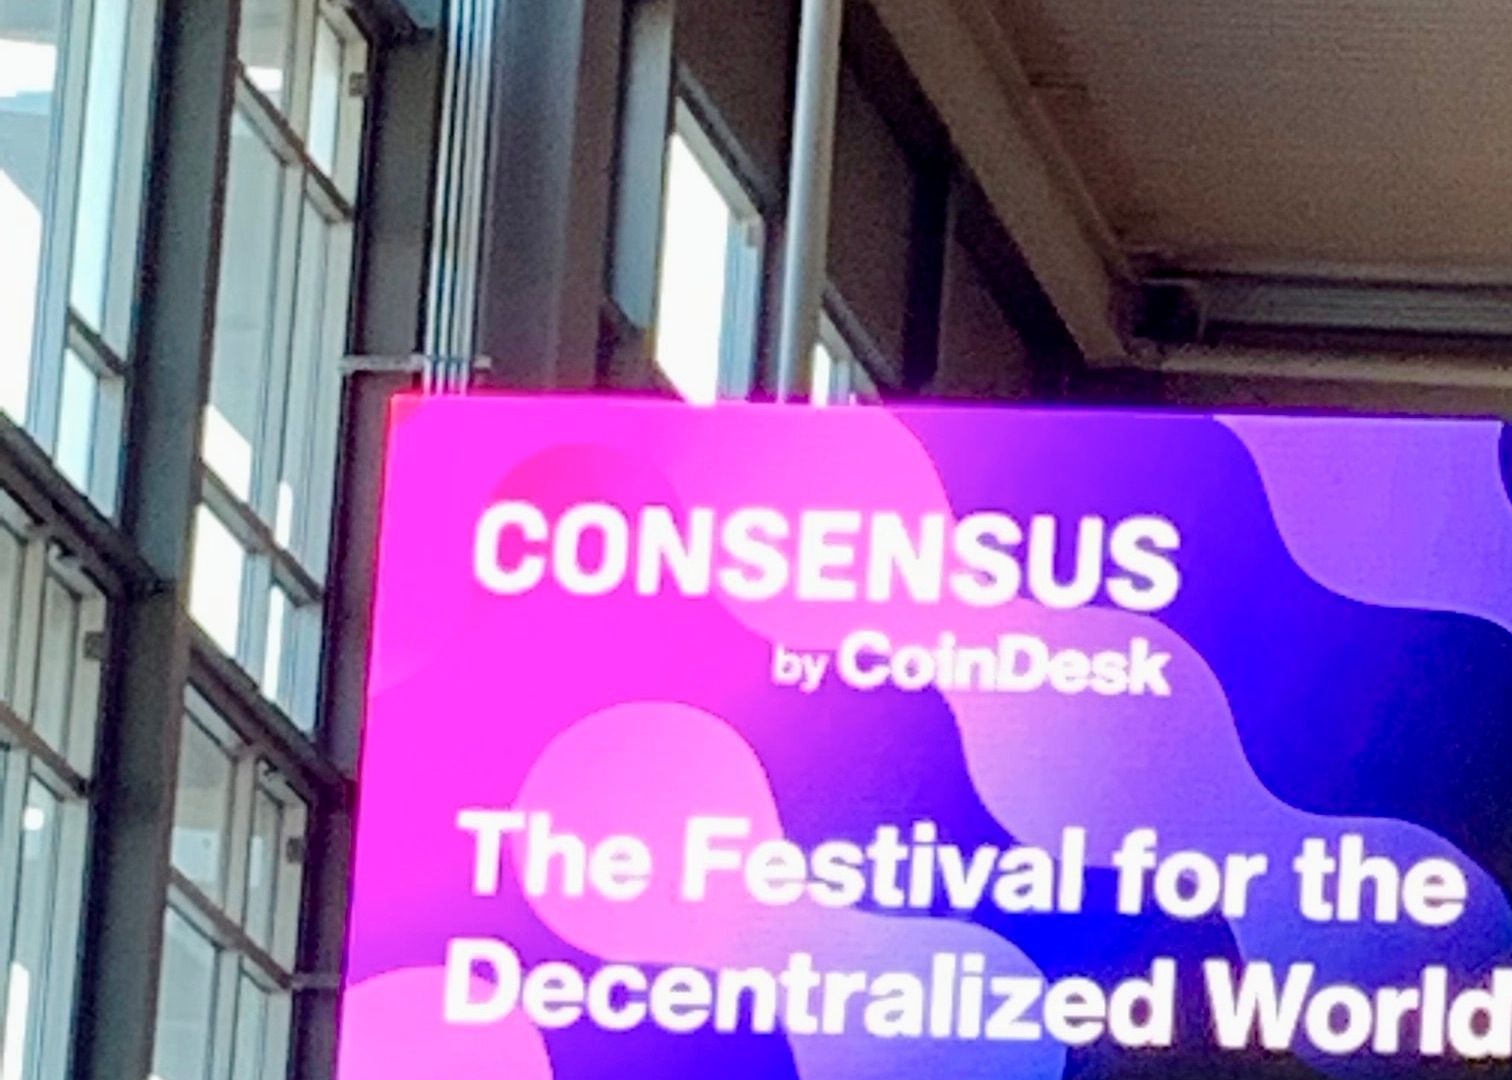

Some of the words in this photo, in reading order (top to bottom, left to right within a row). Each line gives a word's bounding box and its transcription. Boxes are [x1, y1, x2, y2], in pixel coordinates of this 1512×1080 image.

[472, 499, 1182, 611] CONSENSUS
[771, 643, 830, 692] by
[836, 629, 1171, 697] CoinDesk
[456, 809, 652, 900] The
[681, 815, 1086, 914] Festival
[1112, 827, 1268, 920] for
[1293, 832, 1469, 926] the
[442, 936, 1178, 1047] Decentralized
